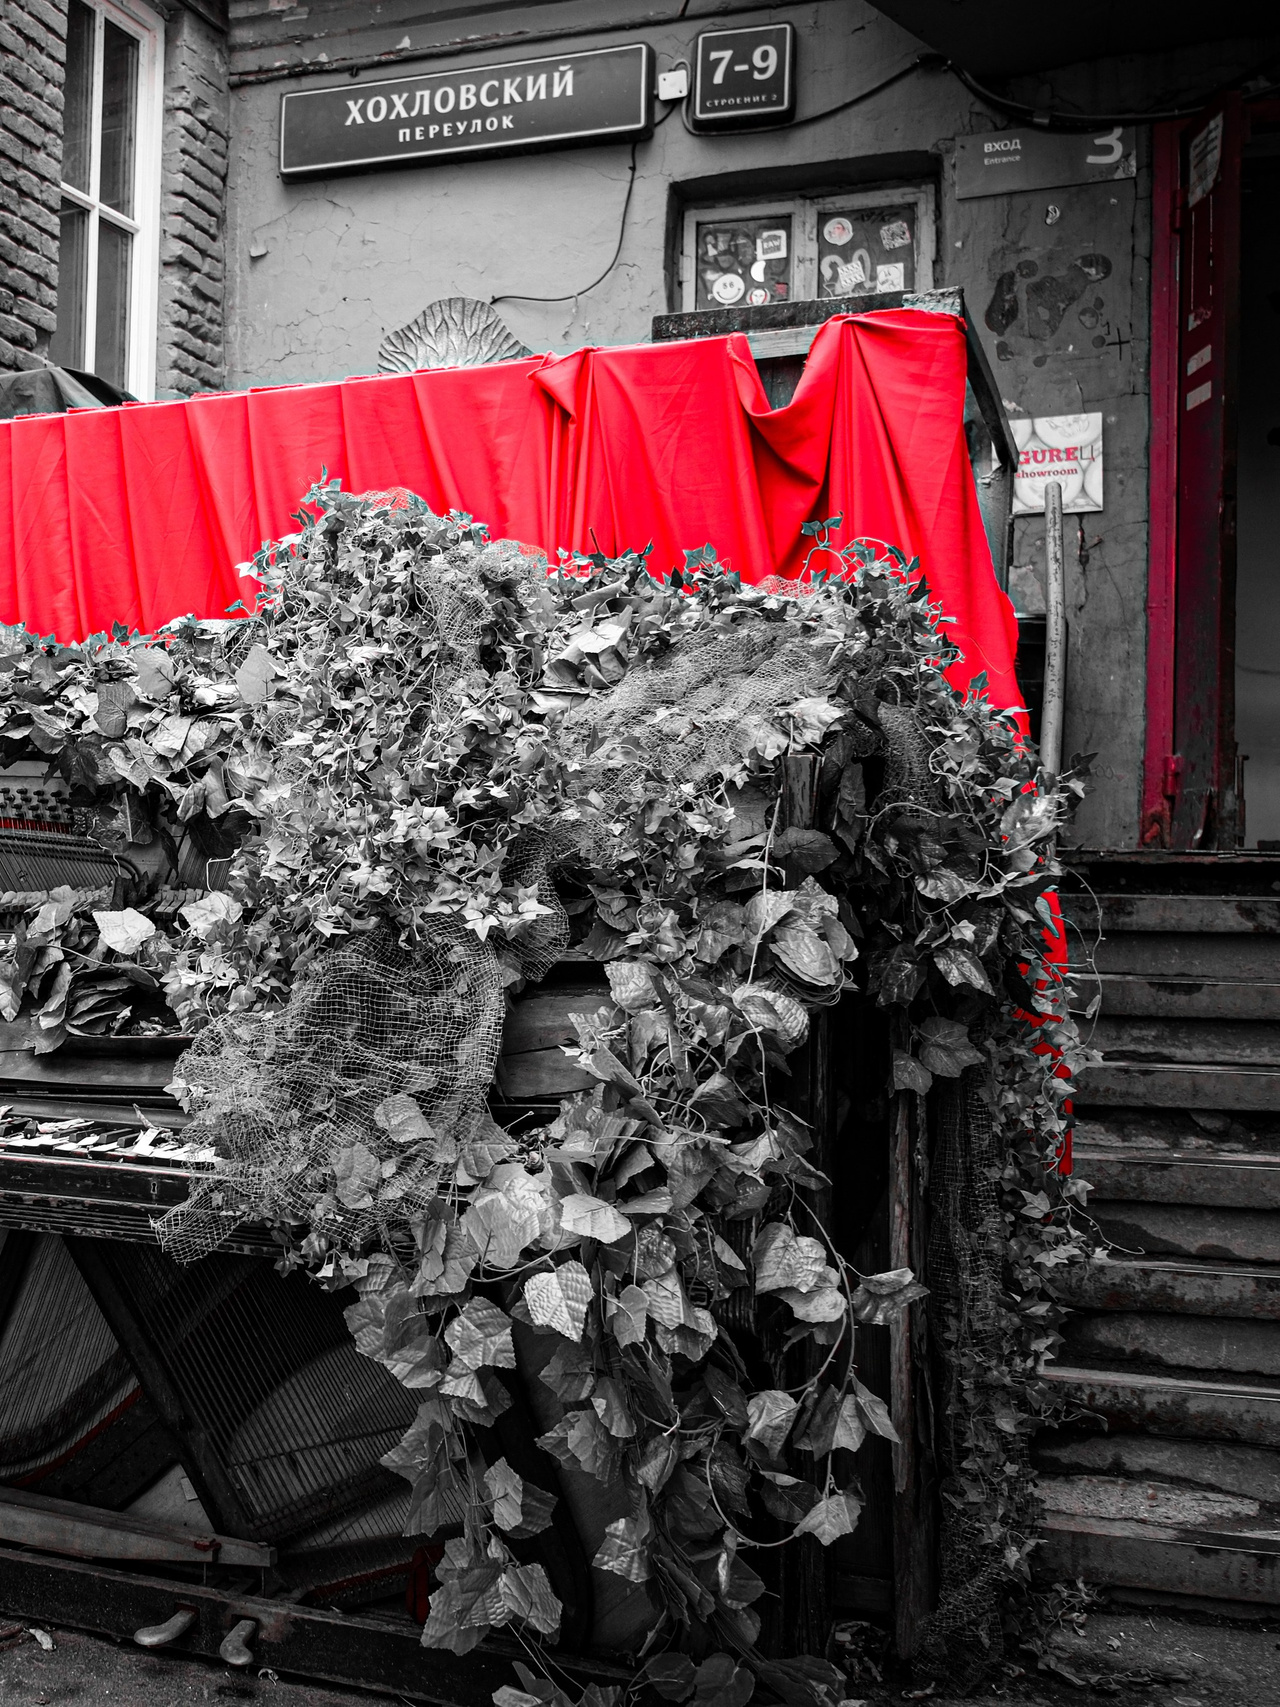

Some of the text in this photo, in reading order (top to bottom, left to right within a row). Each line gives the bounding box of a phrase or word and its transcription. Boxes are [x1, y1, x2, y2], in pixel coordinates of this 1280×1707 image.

[709, 45, 778, 85] 7-9
[344, 64, 574, 126] ХОХЛОВСКИЙ
[706, 94, 768, 108] СТРОЕНИЕ
[398, 115, 514, 143] ПЕРЕУЛОК
[983, 138, 1022, 153] ВХОД
[983, 154, 1021, 166] Entrance
[763, 238, 781, 250] RAW
[1018, 445, 1096, 465] GUREЦ
[1015, 468, 1079, 479] showroom
